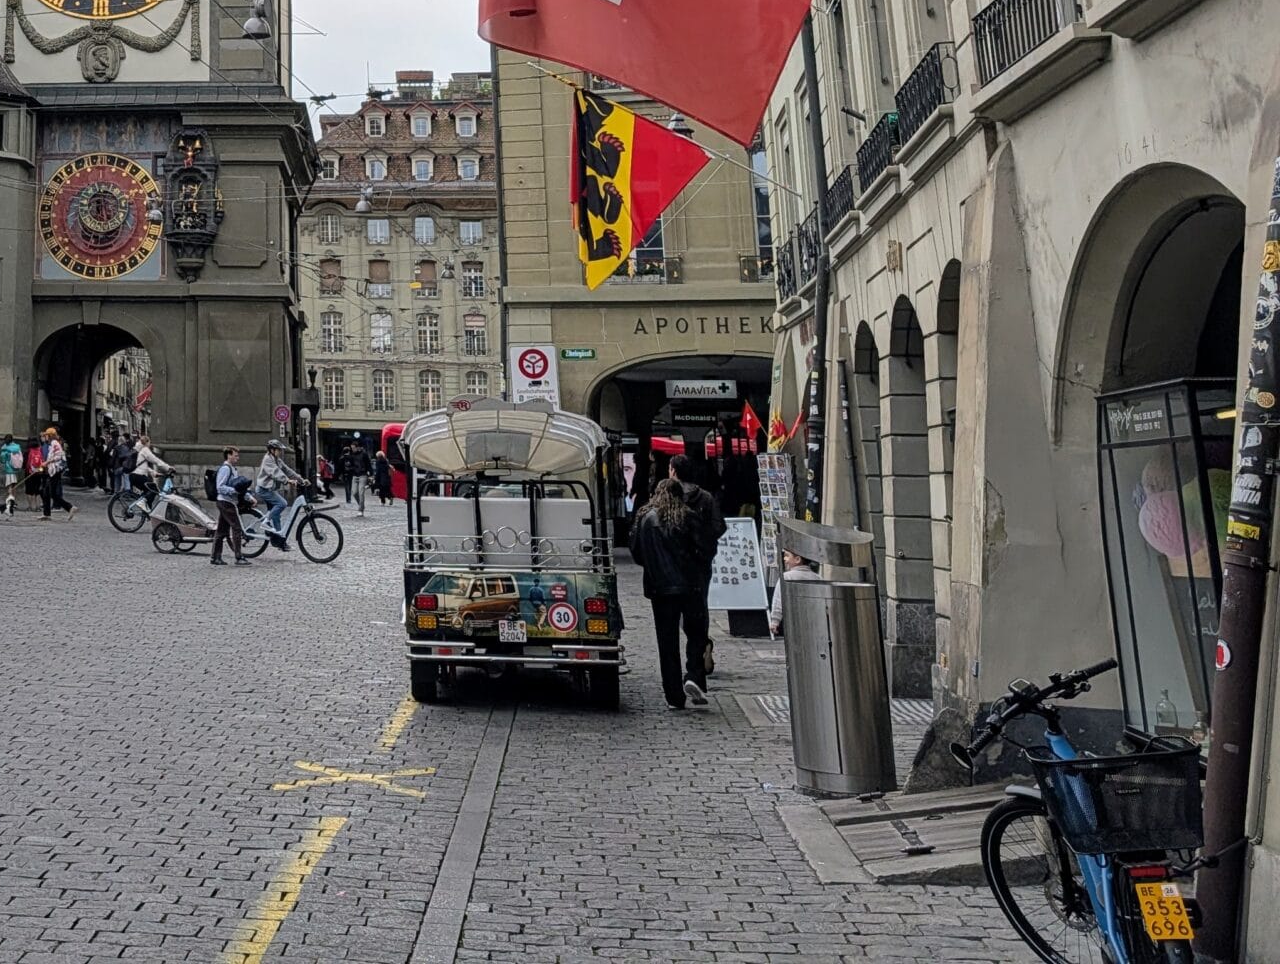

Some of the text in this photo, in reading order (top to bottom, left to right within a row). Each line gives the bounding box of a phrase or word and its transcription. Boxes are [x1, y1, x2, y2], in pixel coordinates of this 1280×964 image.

[633, 316, 775, 335] APOTHEK
[674, 414, 716, 422] McDonald's
[556, 611, 570, 623] 30
[507, 622, 518, 631] BE
[1141, 887, 1156, 897] BE
[1145, 900, 1183, 917] 353
[1151, 920, 1190, 936] 696
